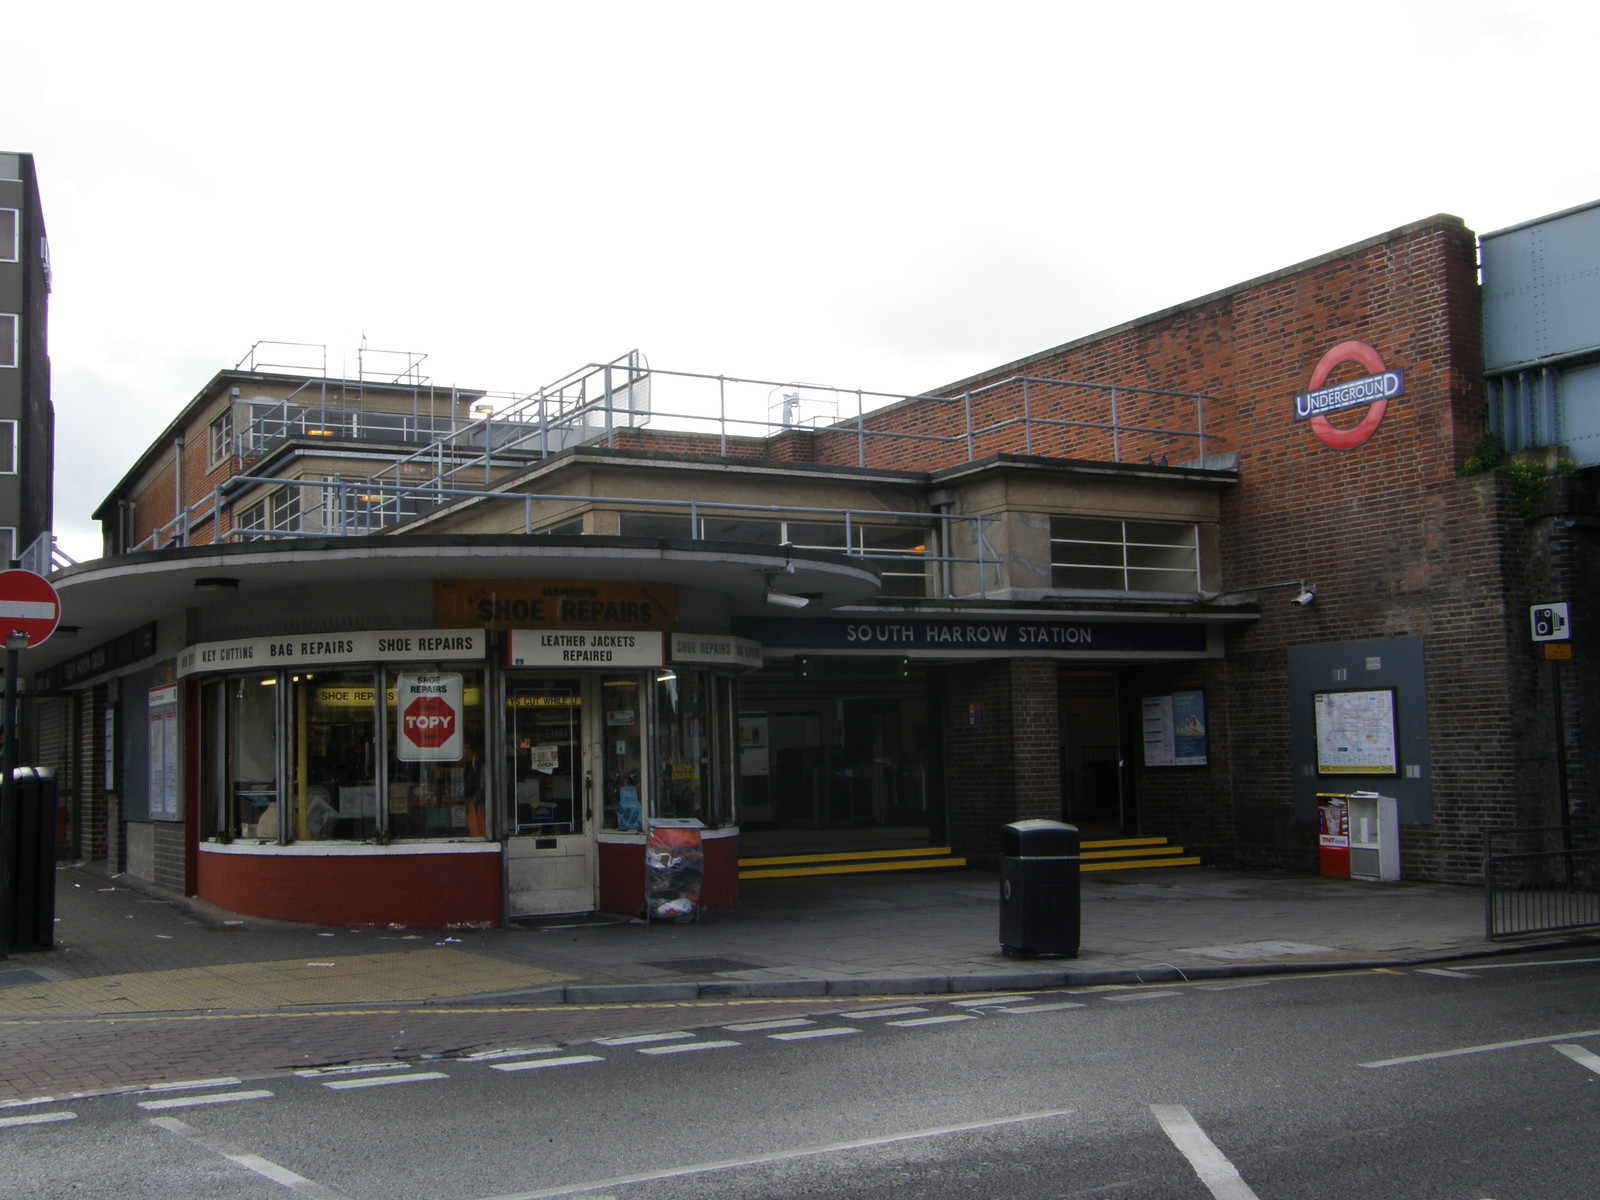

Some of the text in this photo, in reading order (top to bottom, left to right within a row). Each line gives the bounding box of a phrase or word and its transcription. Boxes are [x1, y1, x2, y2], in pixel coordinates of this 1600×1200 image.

[1297, 373, 1399, 416] UNDERGROUND
[543, 587, 598, 598] HARROW
[478, 599, 545, 622] SHOE
[560, 600, 652, 624] REPAIRS
[847, 625, 1092, 643] SOUTH HARROW STATION
[378, 637, 473, 652] SHOE REPAIRS
[541, 635, 635, 647] LEATHER JACKETS
[202, 646, 254, 663] KEY CUTTING
[270, 640, 353, 656] BAG REPAIRS
[677, 641, 731, 655] SHOE REPAIRS
[563, 650, 613, 662] REPAIRED
[417, 676, 441, 684] SHOE
[321, 691, 395, 701] SHOE REPS
[506, 697, 521, 706] EYS
[523, 697, 539, 706] CUT
[406, 716, 453, 729] TOPY
